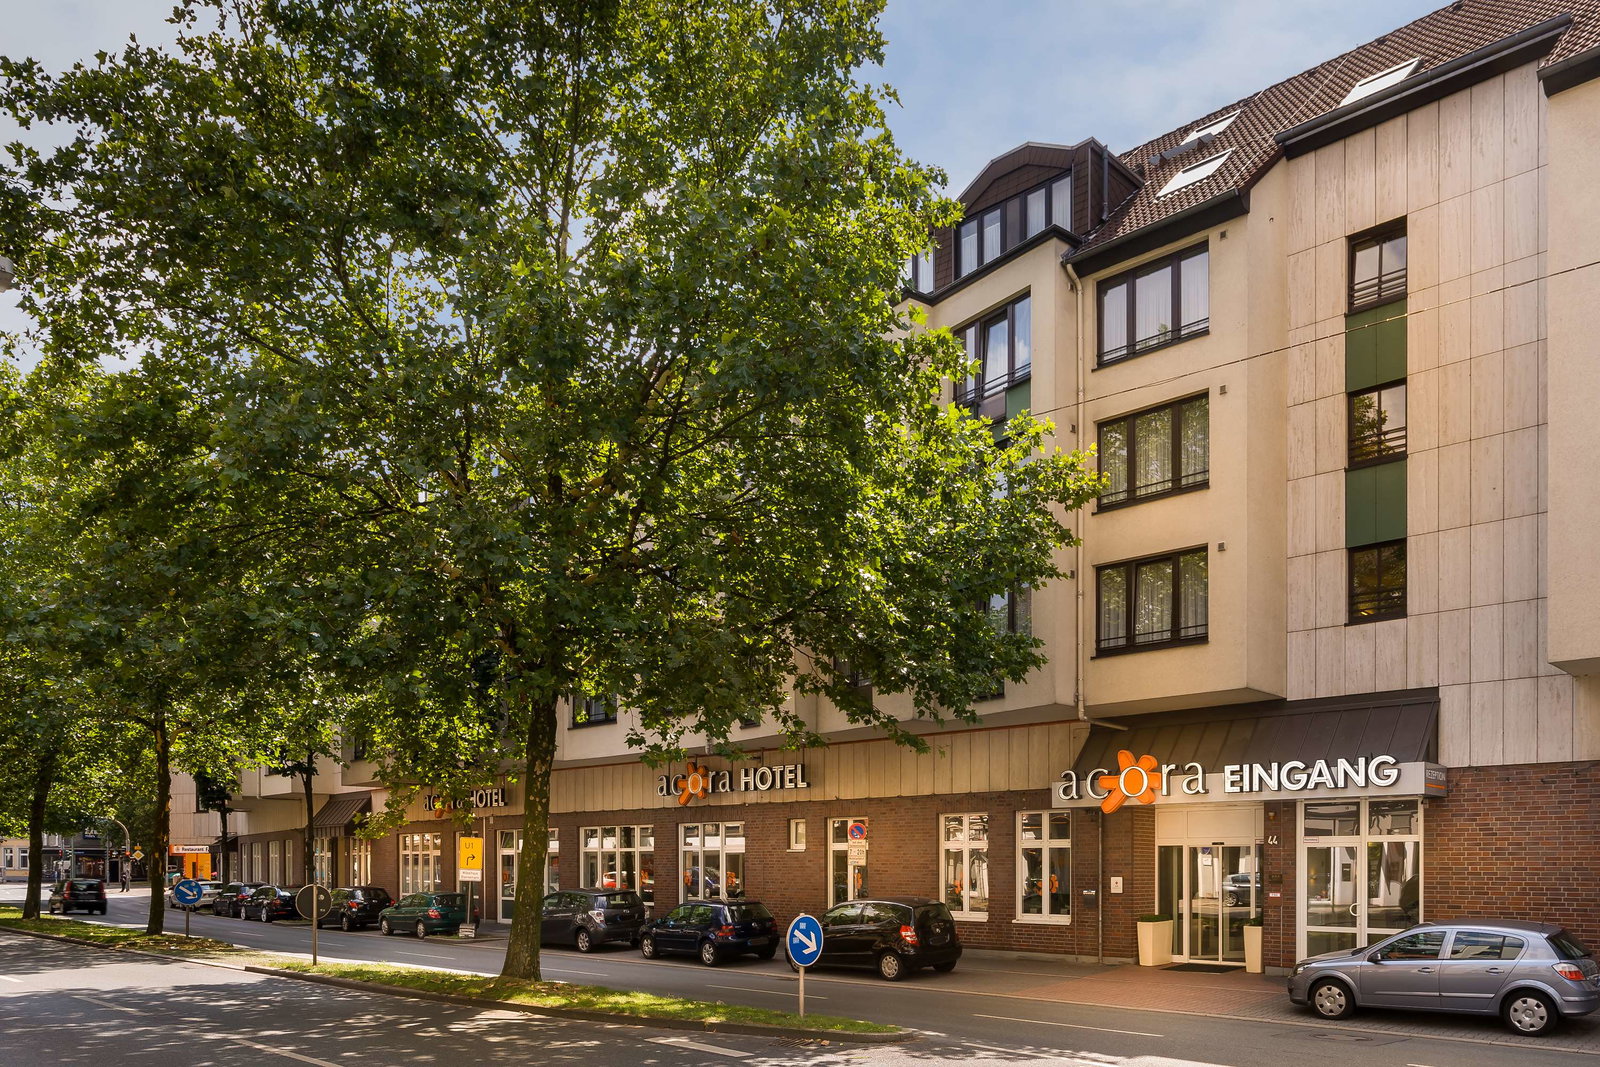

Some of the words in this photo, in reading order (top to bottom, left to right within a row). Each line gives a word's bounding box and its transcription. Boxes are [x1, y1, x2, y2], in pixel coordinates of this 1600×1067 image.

[657, 769, 732, 797] acora
[740, 764, 808, 791] HOTEL
[1057, 762, 1208, 800] acora
[1223, 755, 1399, 793] EINGANG
[470, 788, 505, 808] HOTEL
[1267, 835, 1278, 845] 44
